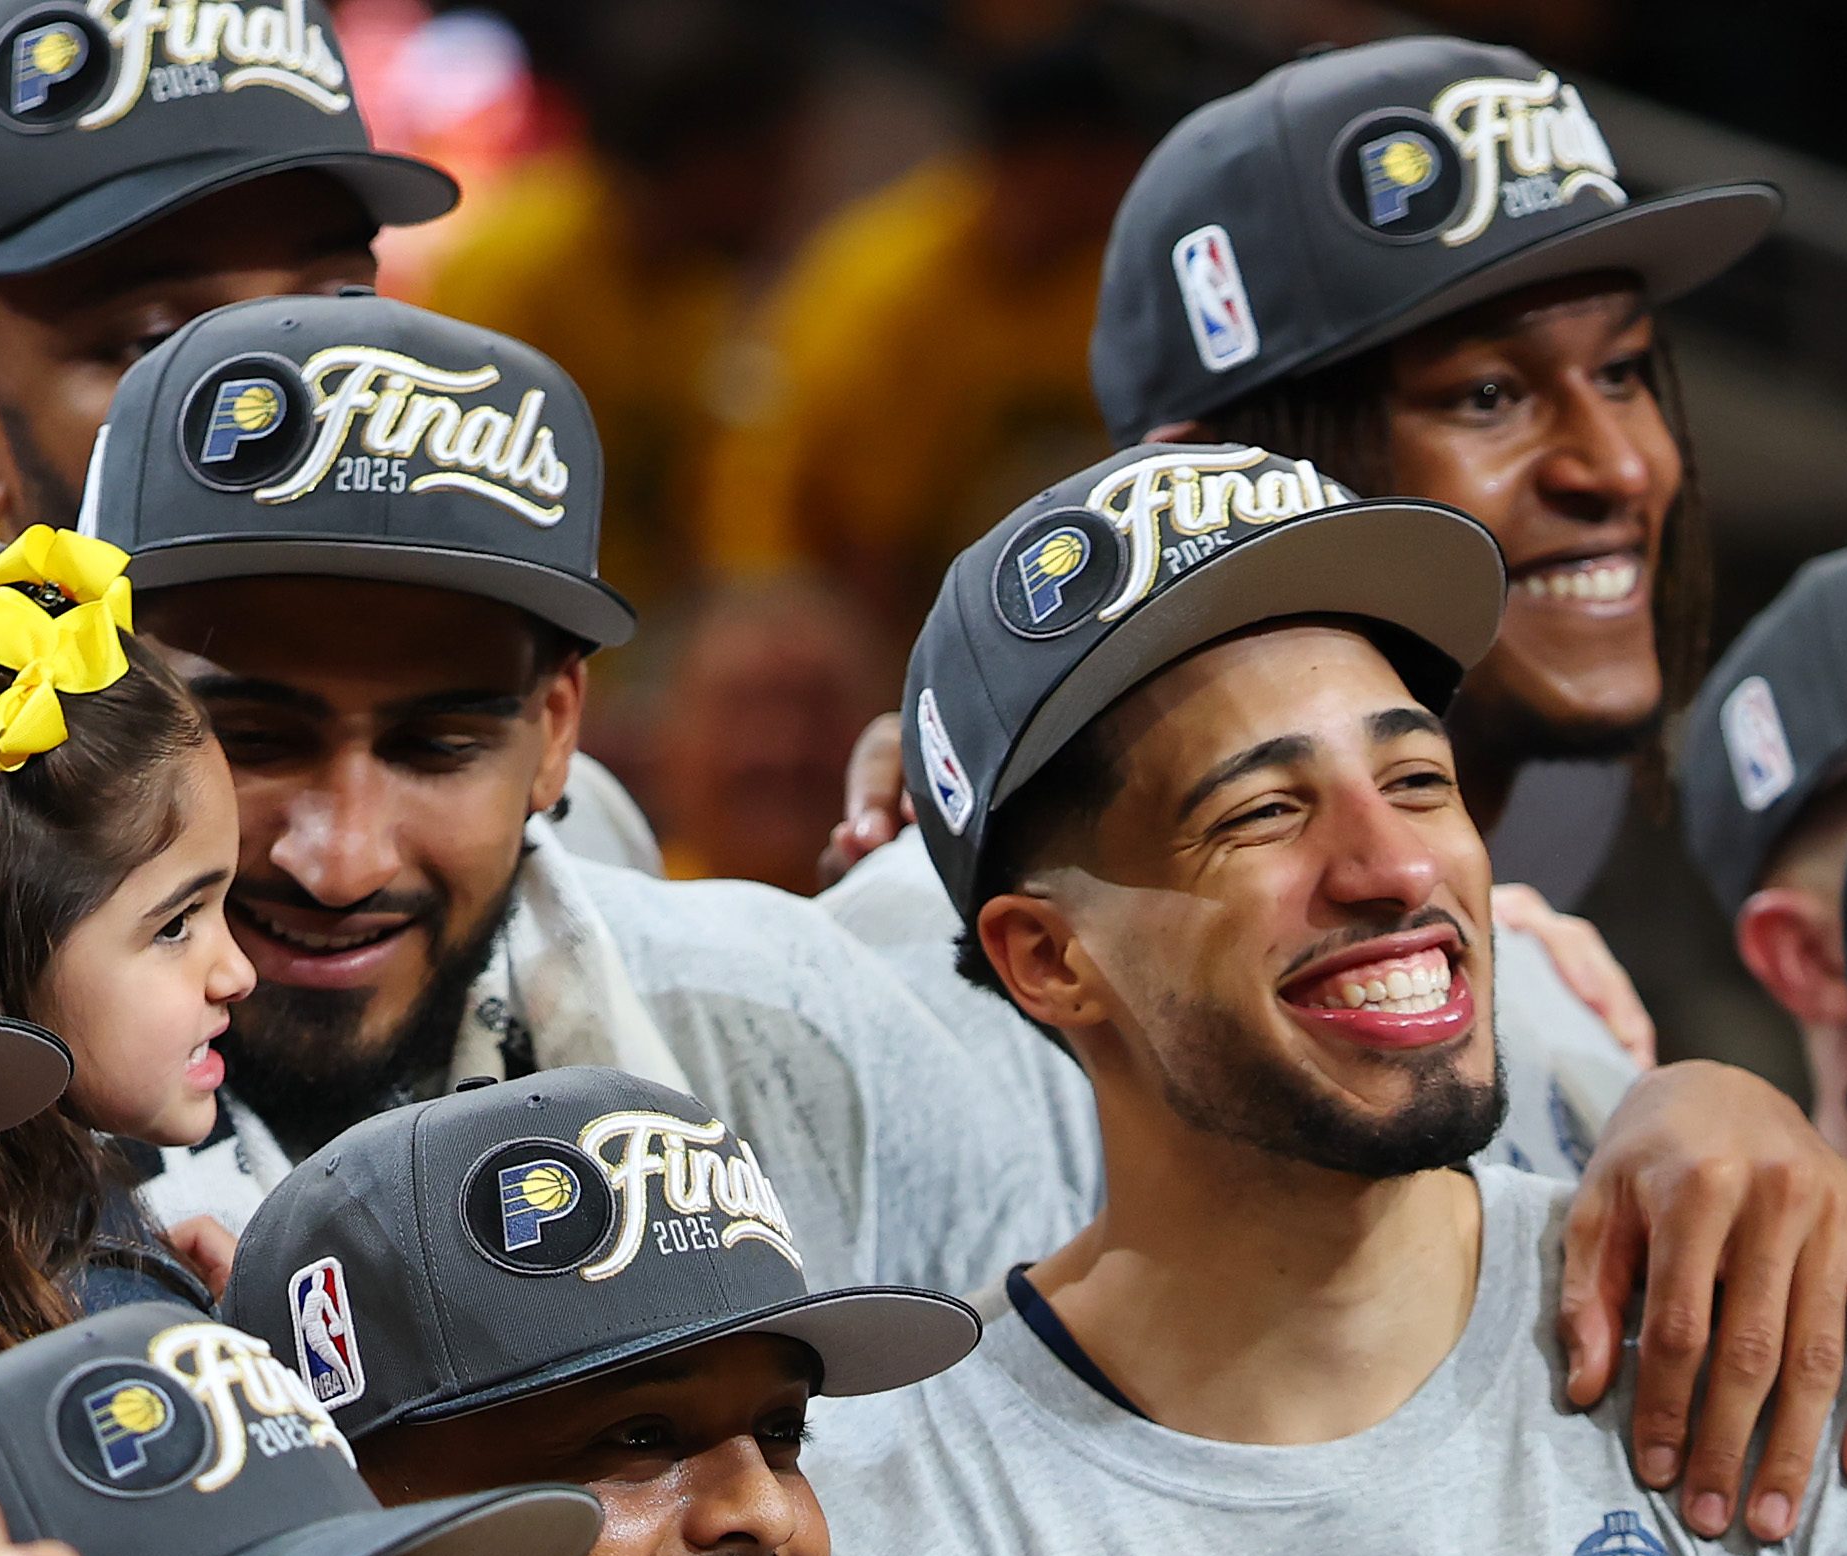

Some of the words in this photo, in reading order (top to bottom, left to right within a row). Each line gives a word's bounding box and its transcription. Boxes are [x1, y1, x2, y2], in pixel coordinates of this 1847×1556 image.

[254, 345, 571, 506] Finals
[335, 456, 409, 493] 2025
[653, 1216, 719, 1256] 2025
